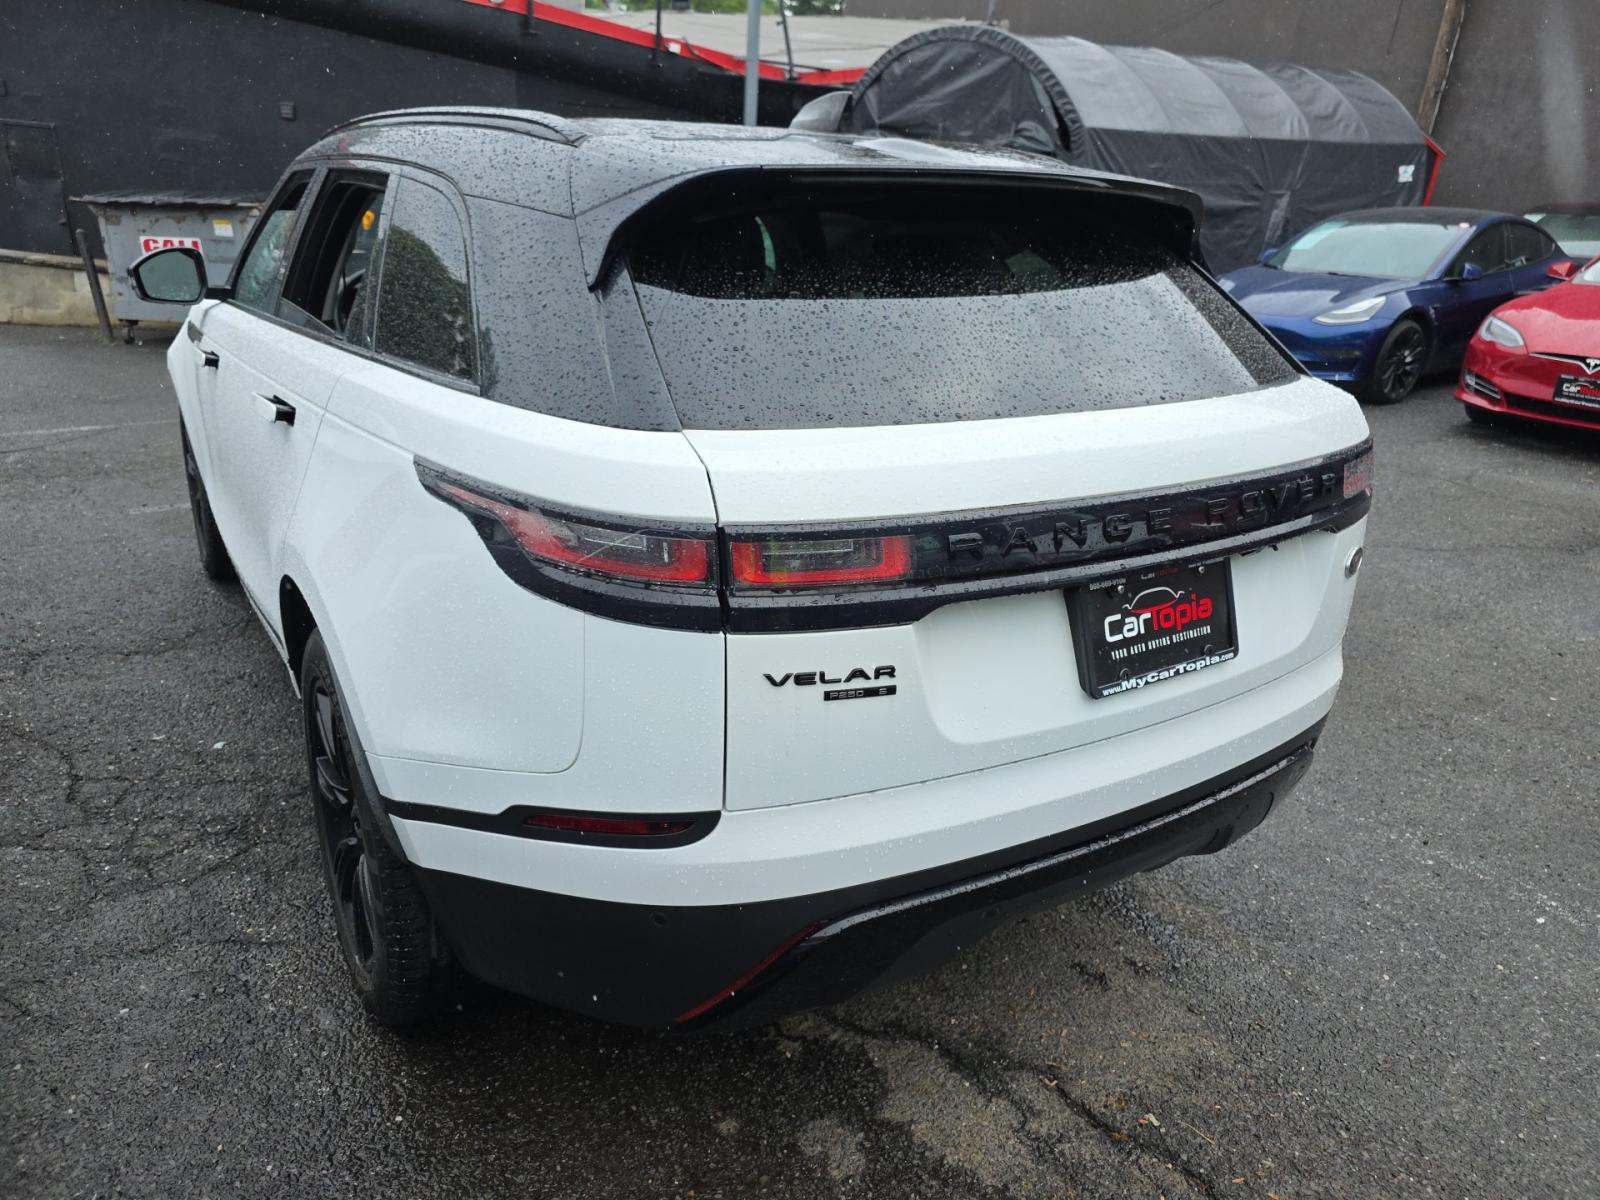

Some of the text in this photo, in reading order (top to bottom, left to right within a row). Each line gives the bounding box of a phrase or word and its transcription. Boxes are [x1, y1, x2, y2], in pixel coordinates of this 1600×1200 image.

[947, 471, 1338, 563] RANGE ROVER
[1104, 592, 1213, 643] CarTopia
[1130, 643, 1146, 655] AUTO
[763, 664, 897, 687] VELAR
[1102, 651, 1235, 697] www.MyCarTopia.com
